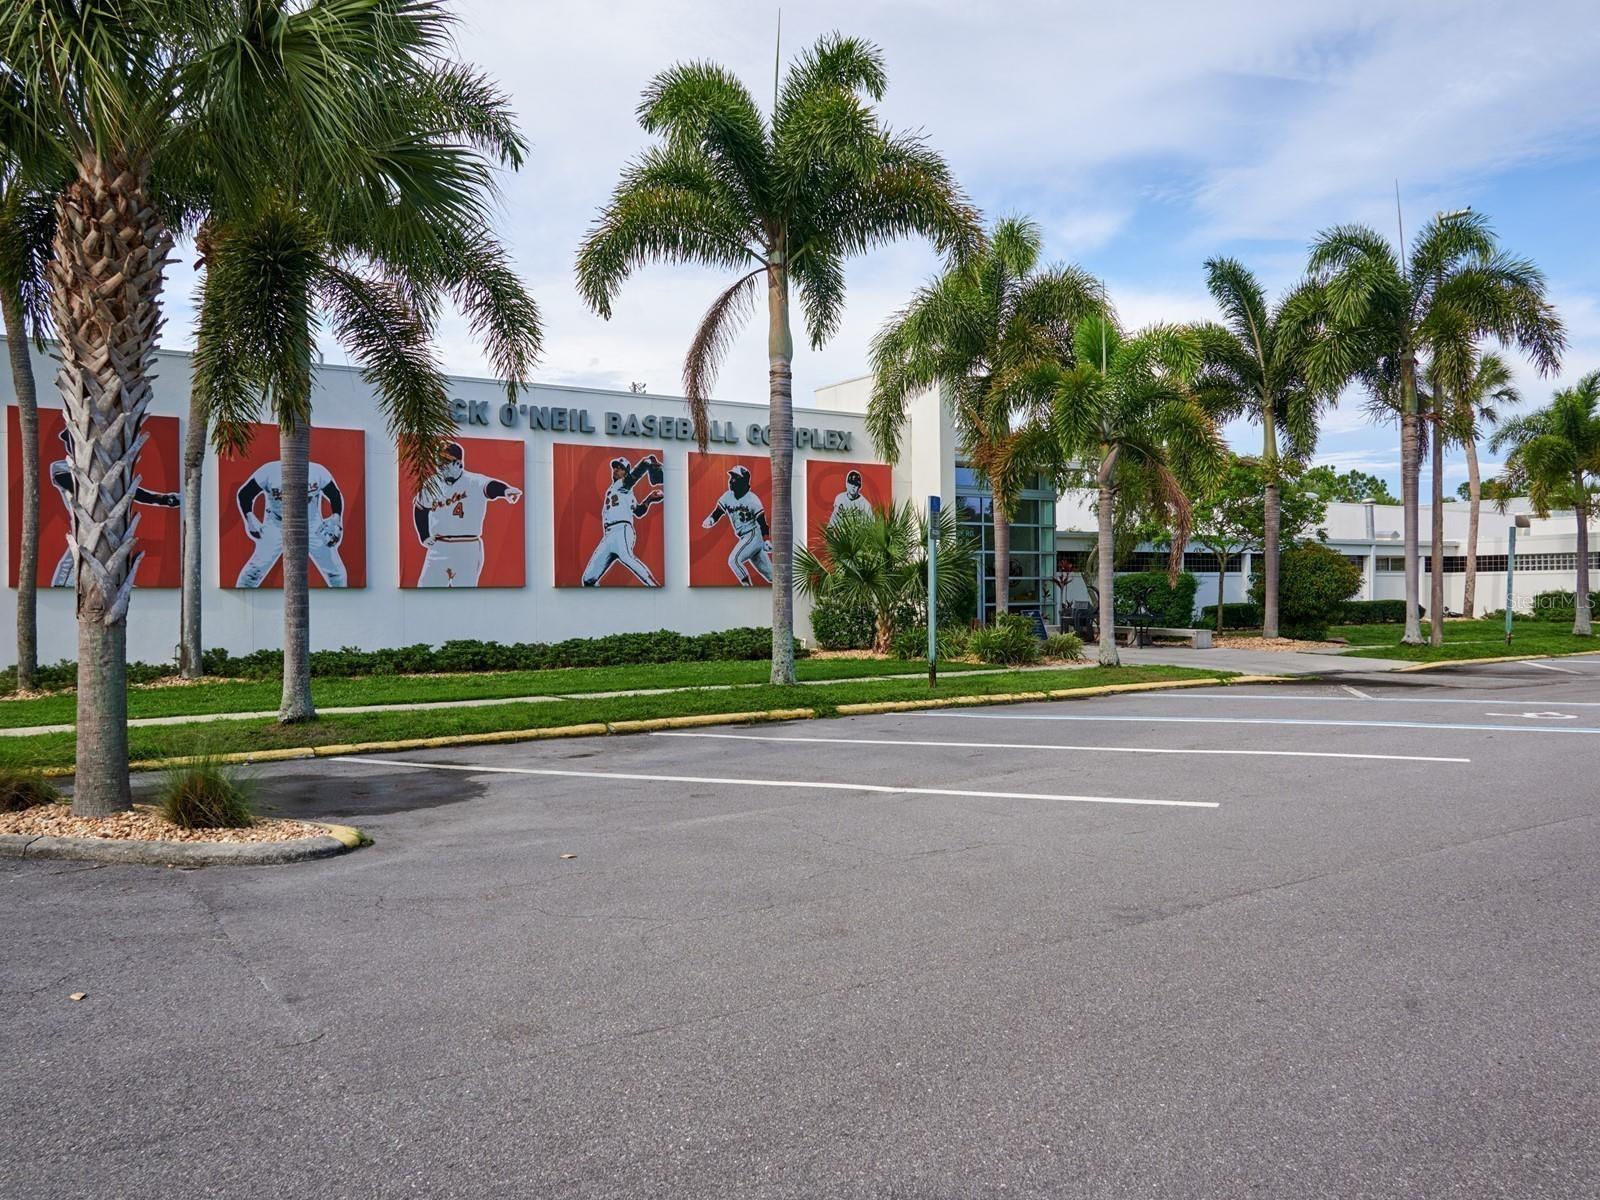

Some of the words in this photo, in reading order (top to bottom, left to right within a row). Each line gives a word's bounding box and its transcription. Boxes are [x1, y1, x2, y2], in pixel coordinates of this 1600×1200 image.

[499, 403, 595, 434] O'NEIL
[746, 423, 853, 452] COPLEX
[452, 501, 465, 518] 4
